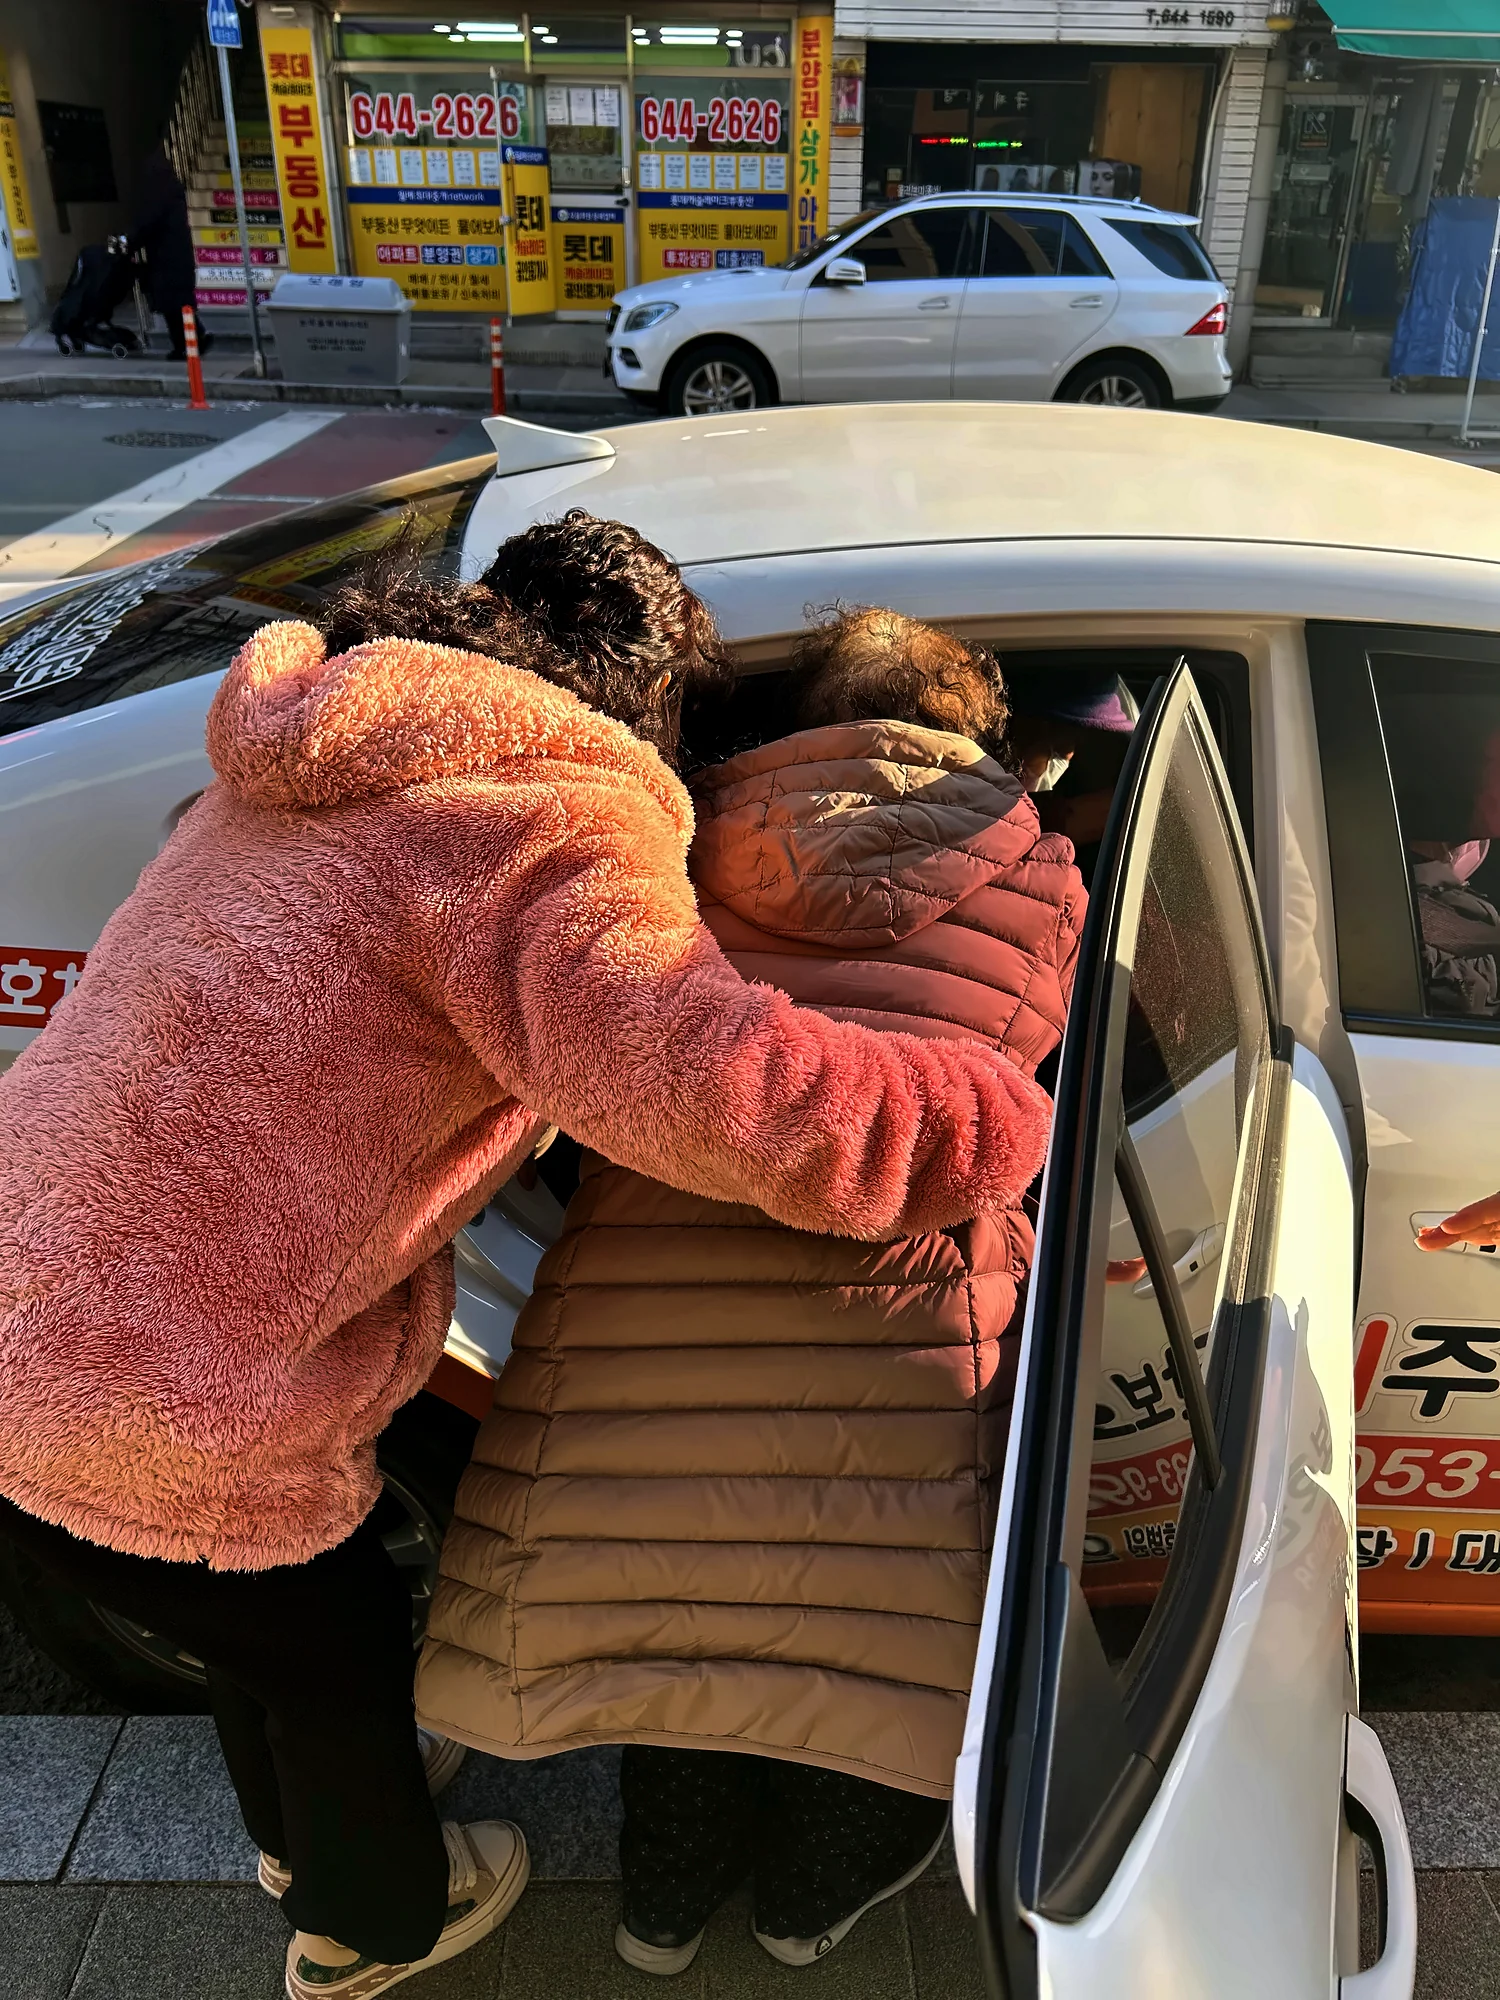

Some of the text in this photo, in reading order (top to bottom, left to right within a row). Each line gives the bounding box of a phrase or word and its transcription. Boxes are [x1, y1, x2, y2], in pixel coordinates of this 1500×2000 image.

[268, 53, 311, 79] 롯데
[801, 28, 822, 119] 분양권
[351, 93, 521, 138] 644-2626
[641, 97, 780, 143] 644-2626
[278, 104, 327, 250] 부동산
[799, 129, 820, 186] 상가
[377, 246, 496, 265] 아파트 분양권 상가
[563, 235, 613, 262] 롯데
